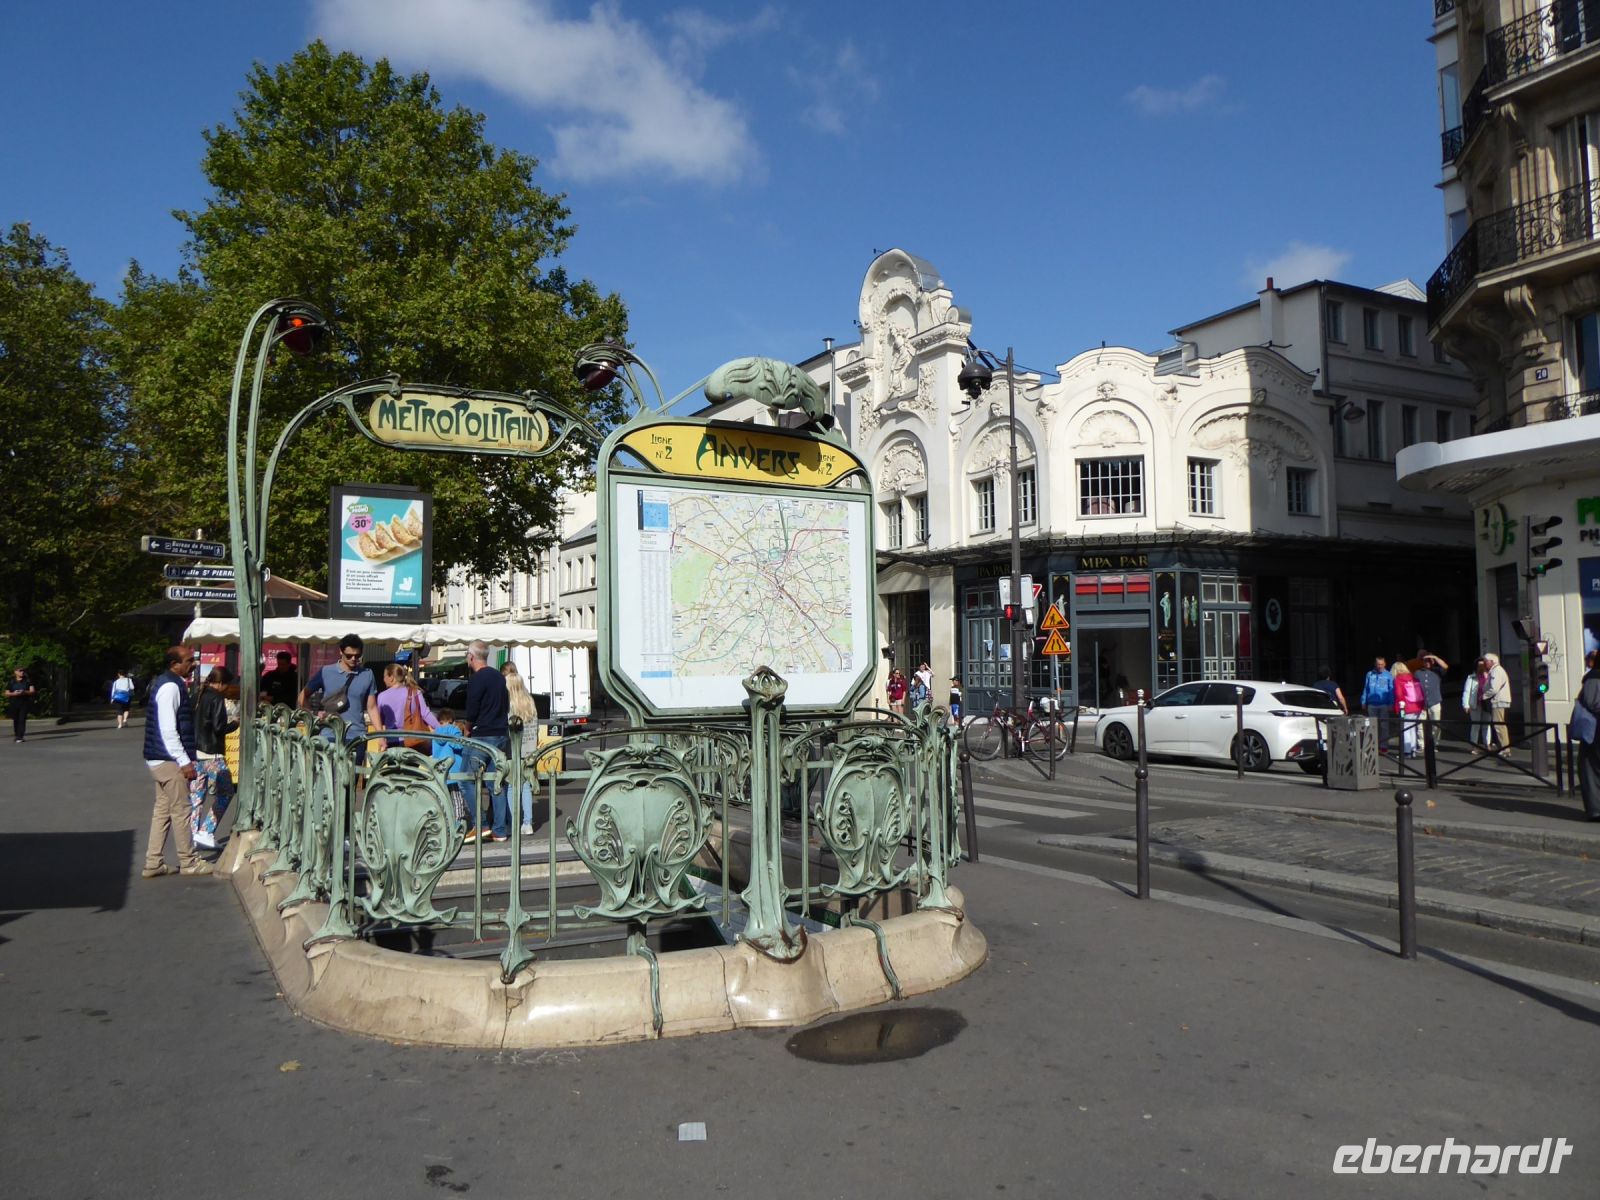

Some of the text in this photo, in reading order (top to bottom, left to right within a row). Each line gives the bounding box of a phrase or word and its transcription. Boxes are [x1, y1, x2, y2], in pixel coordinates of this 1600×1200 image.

[1536, 370, 1546, 379] 70
[377, 399, 543, 444] METROPOLITAIN
[665, 446, 673, 460] 2
[696, 432, 801, 480] ANVERS
[825, 463, 832, 476] 2
[1082, 555, 1148, 569] MPA PAR
